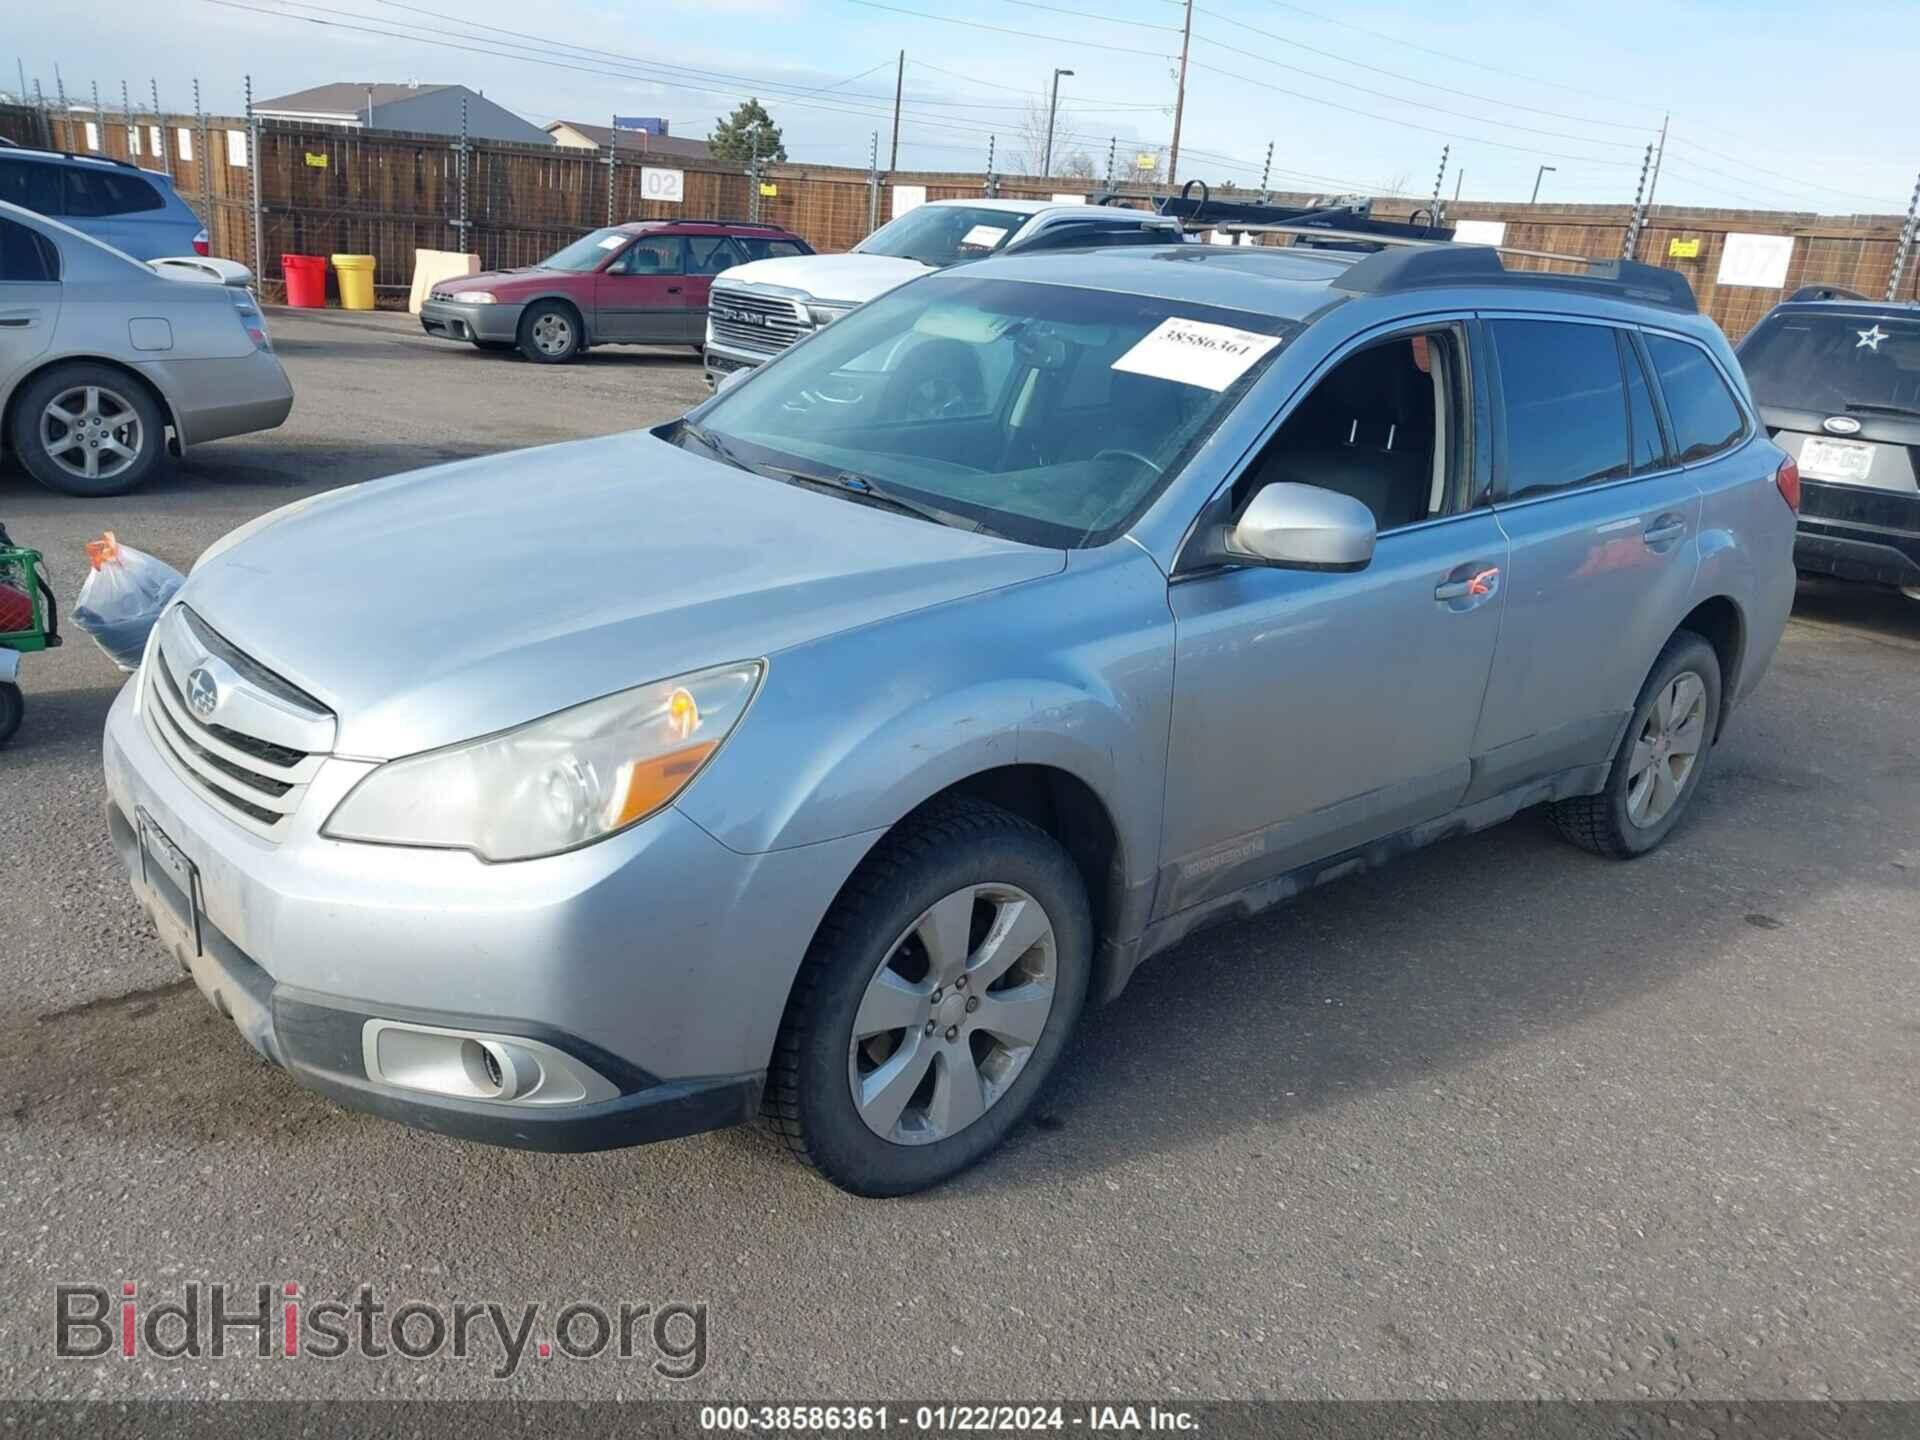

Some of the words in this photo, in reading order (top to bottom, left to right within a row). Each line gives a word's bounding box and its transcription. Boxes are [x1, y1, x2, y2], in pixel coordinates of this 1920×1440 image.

[648, 173, 677, 195] 02
[1731, 242, 1781, 279] 07
[724, 309, 763, 325] RAM
[1164, 329, 1251, 356] 38586361
